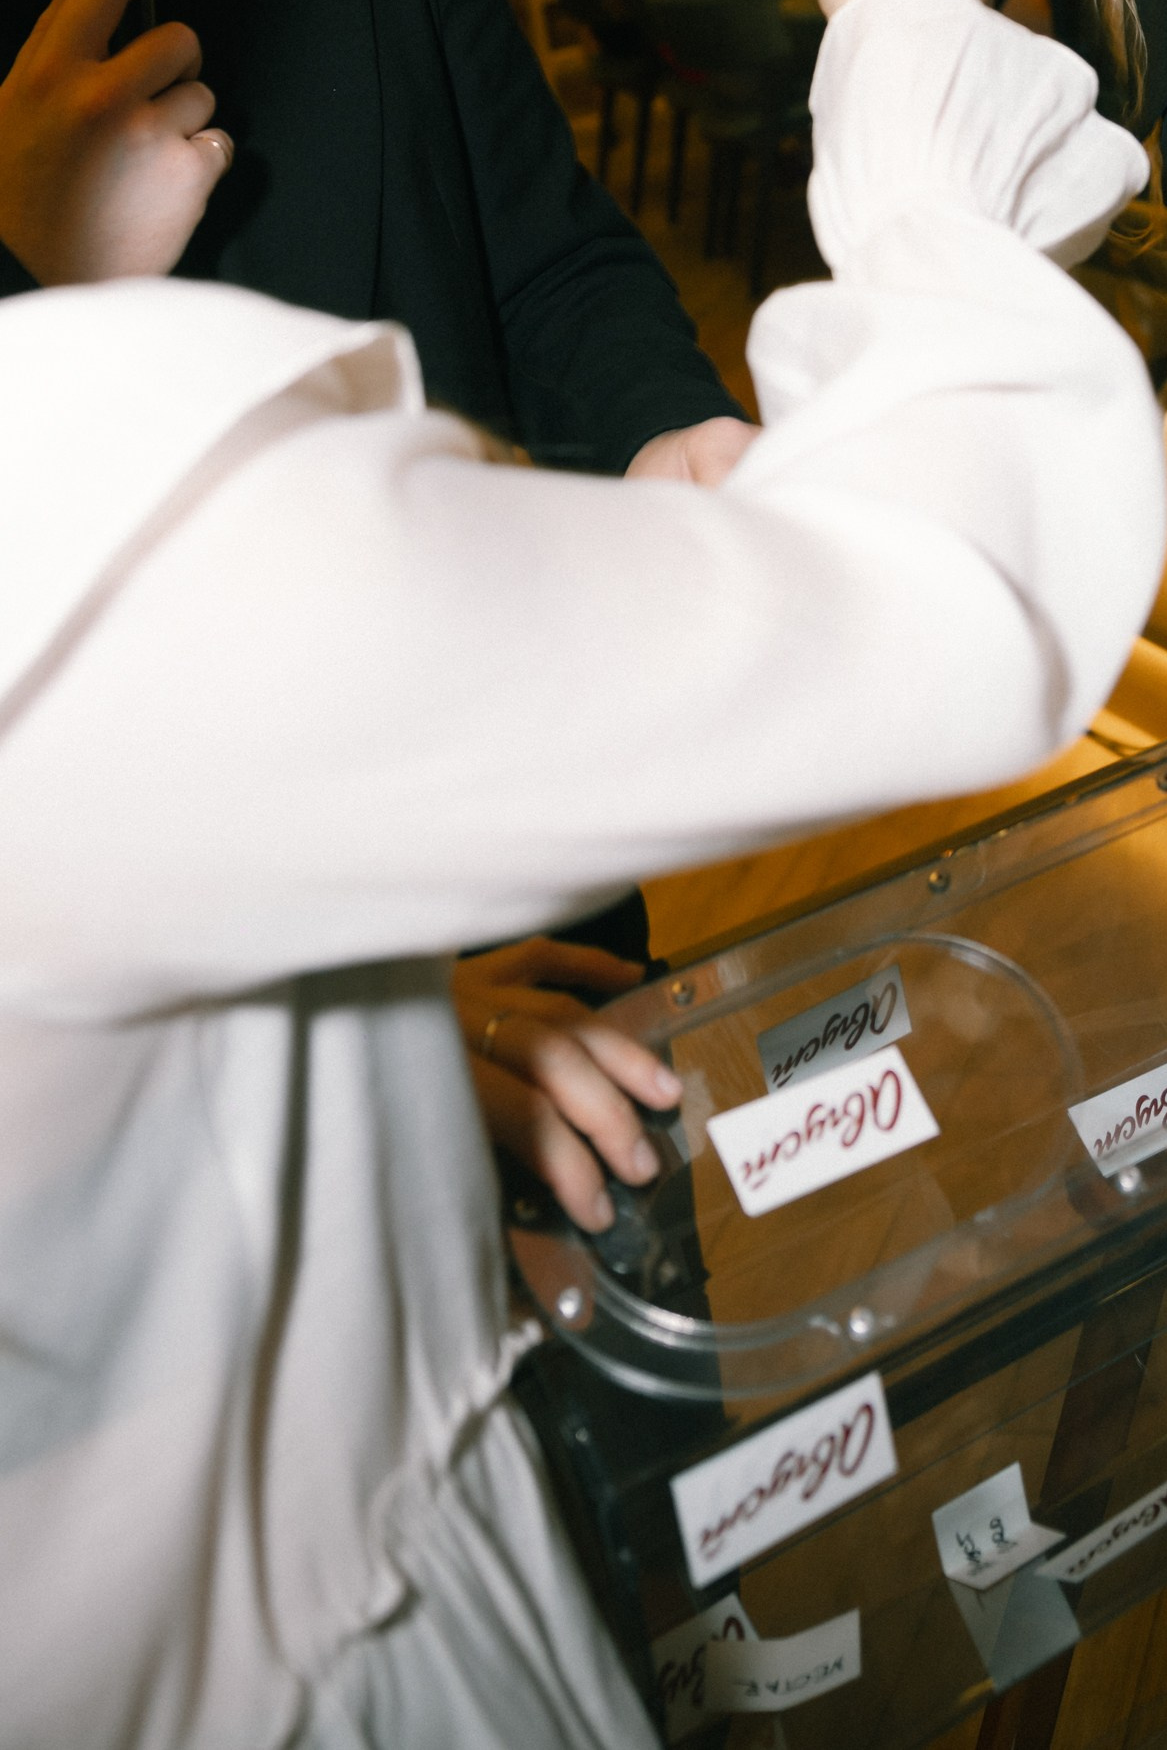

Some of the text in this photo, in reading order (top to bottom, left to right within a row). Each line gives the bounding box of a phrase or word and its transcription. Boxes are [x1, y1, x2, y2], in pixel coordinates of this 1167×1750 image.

[772, 982, 898, 1085] Август
[741, 1068, 904, 1188] Август
[698, 1402, 875, 1560] Август
